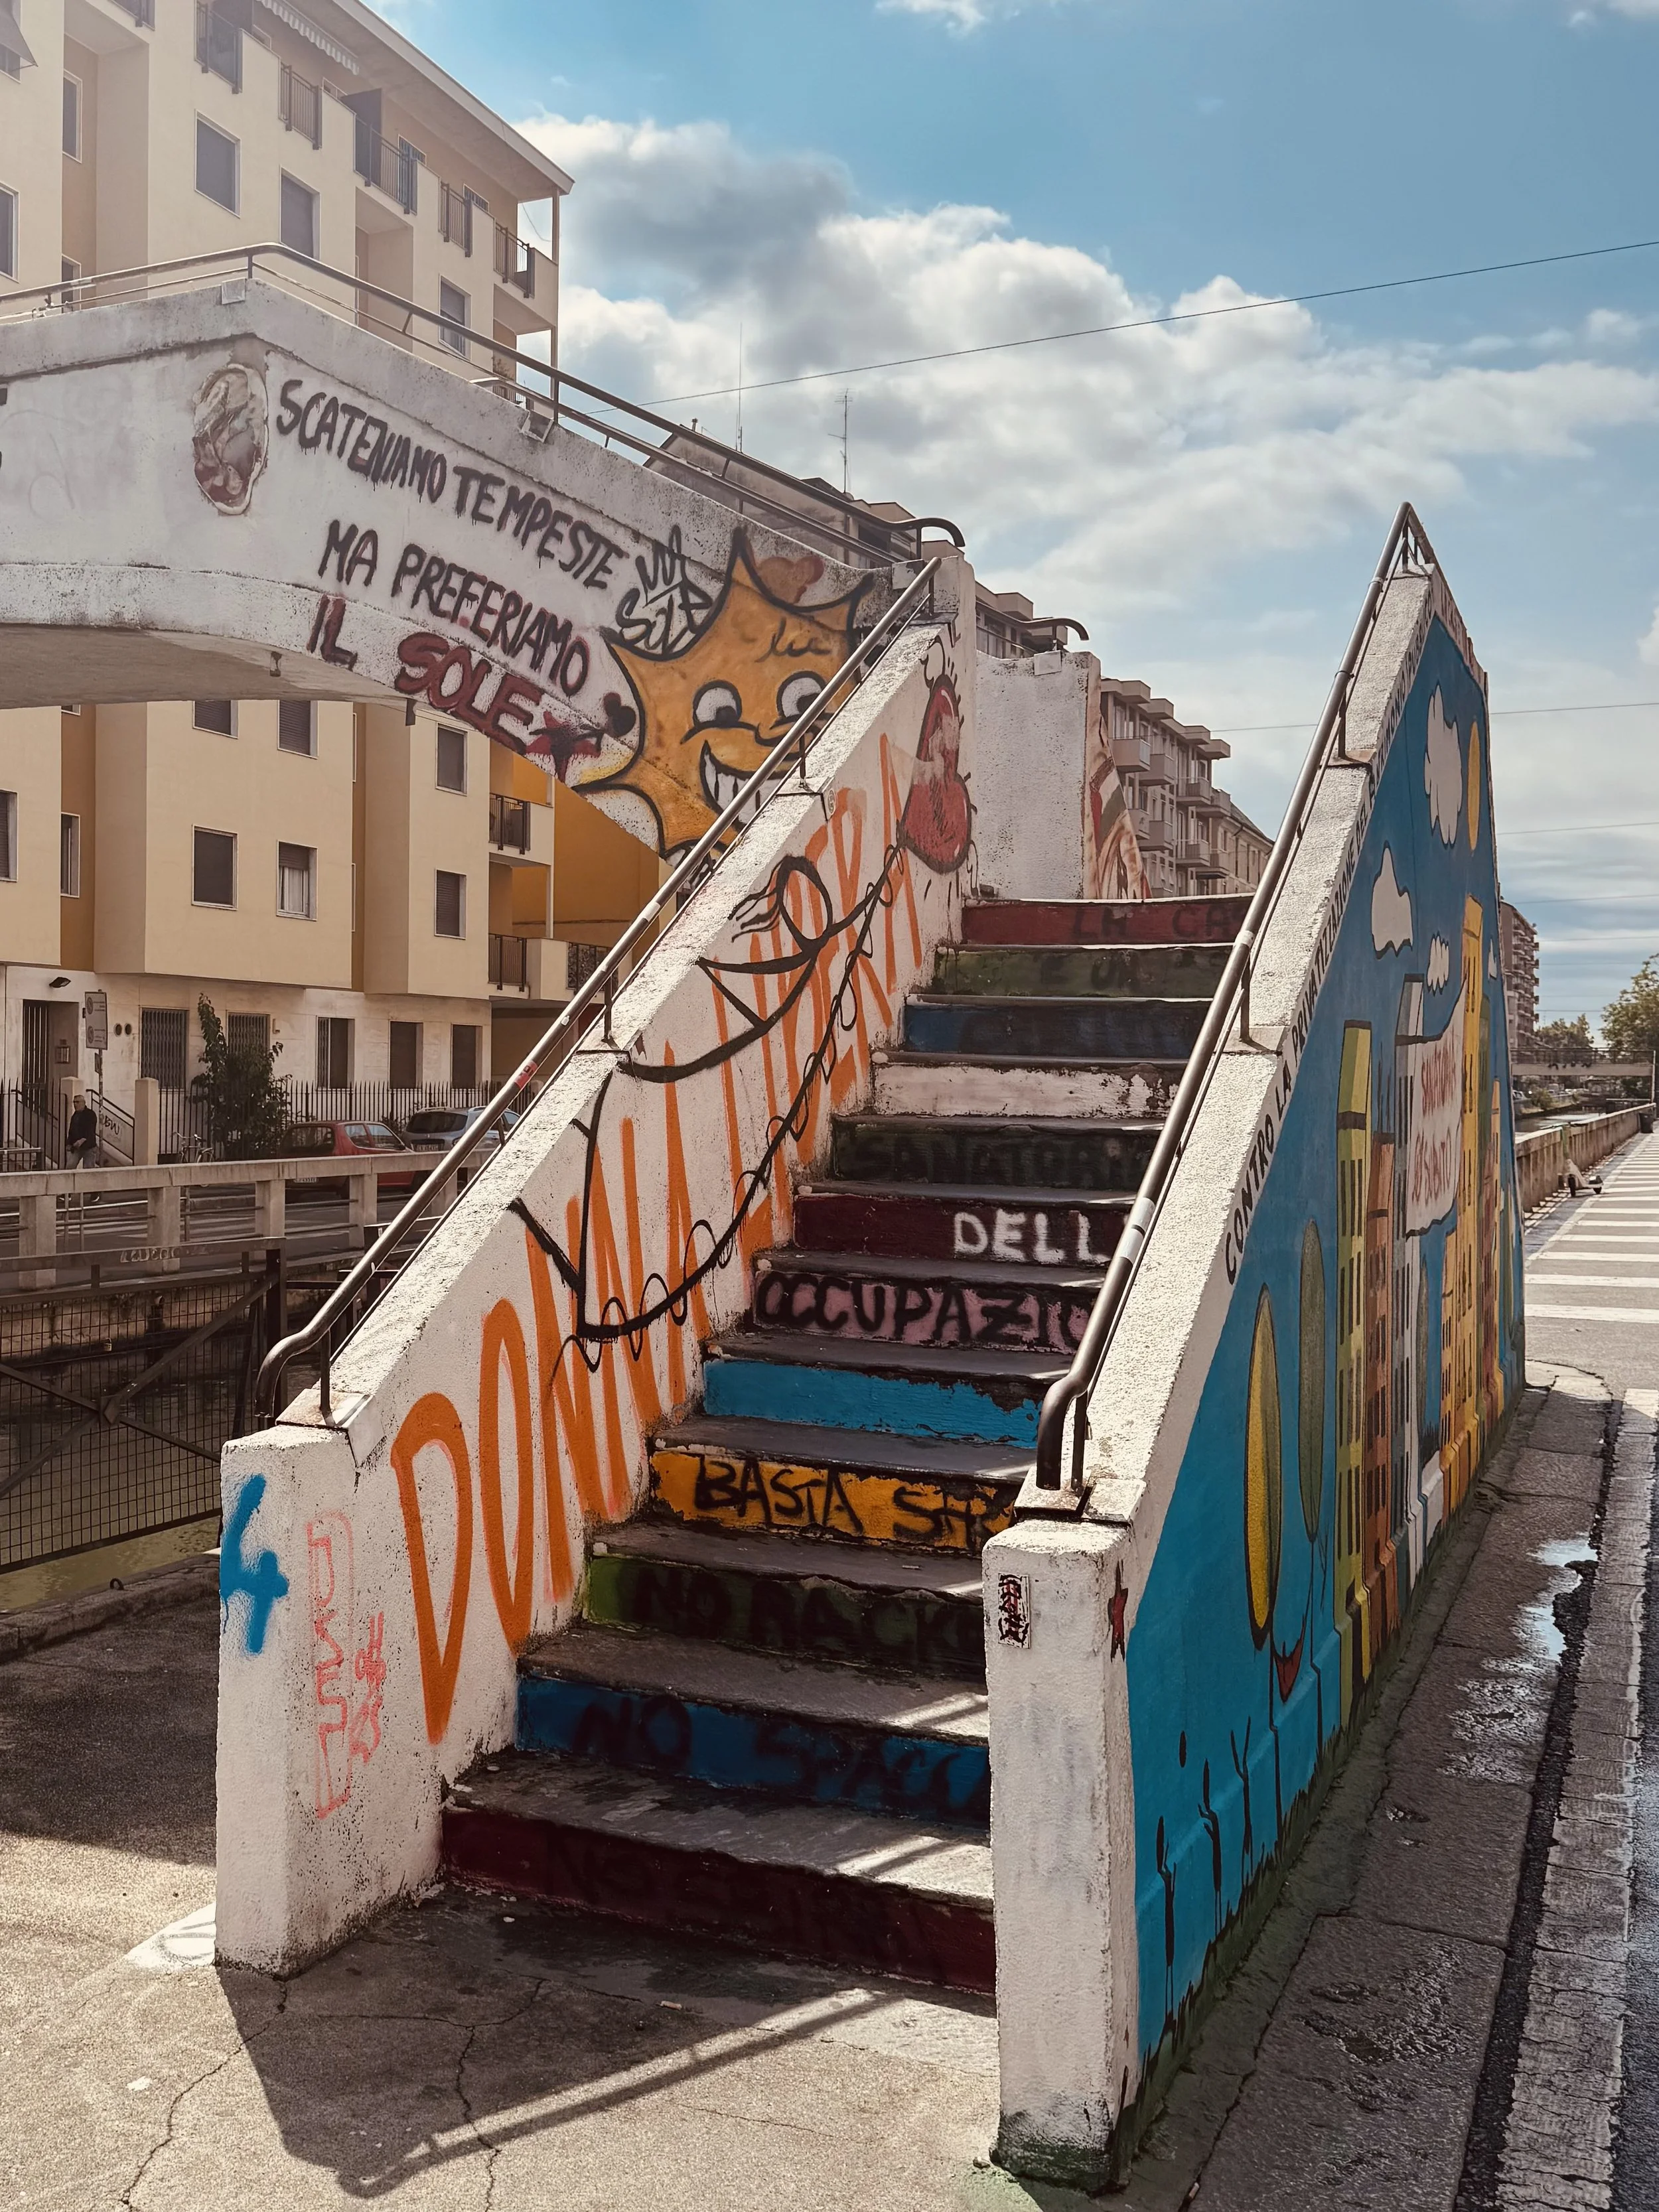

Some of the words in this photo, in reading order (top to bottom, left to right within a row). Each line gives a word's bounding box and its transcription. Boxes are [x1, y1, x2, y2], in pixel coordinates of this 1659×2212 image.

[276, 379, 447, 504] SCATENIAMO
[453, 464, 630, 590] TEMPESTE
[307, 595, 358, 671] IL
[394, 631, 543, 755] SOLE
[319, 518, 378, 587] MA
[390, 543, 590, 697] PREFERIAMO
[1224, 1121, 1275, 1287] CONTRO
[1274, 1060, 1293, 1121] LA
[1289, 836, 1358, 1066] PRIVATIZZAZIONE
[1355, 800, 1370, 856] DEL
[694, 1454, 863, 1535] BASTA
[571, 1692, 695, 1767] NO
[754, 1717, 989, 1823] SPACC
